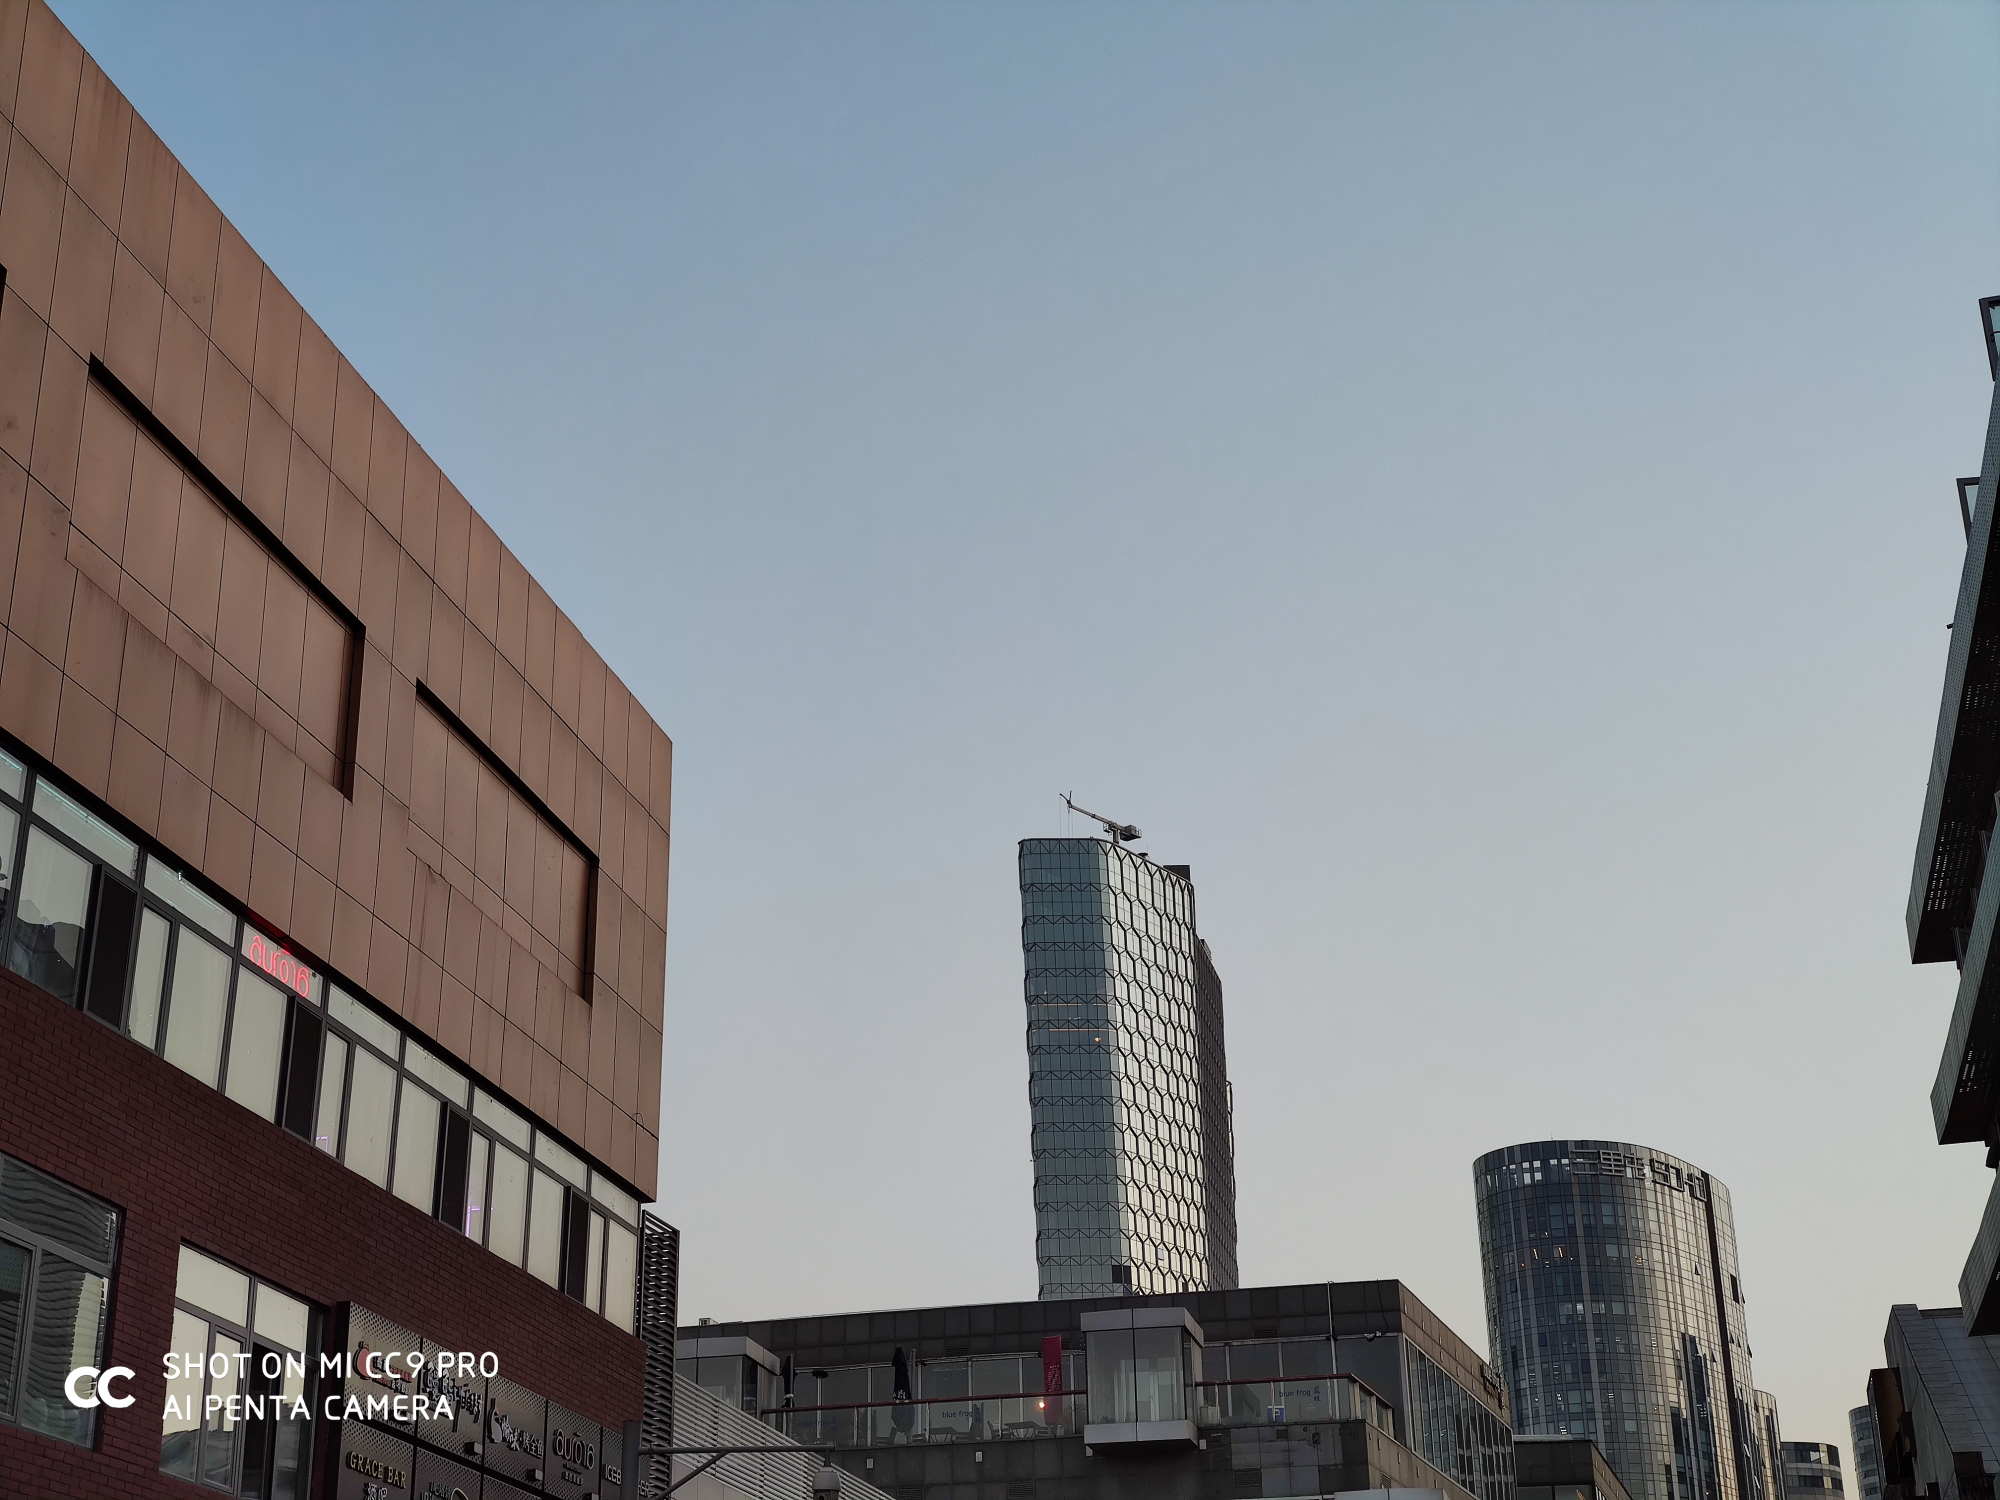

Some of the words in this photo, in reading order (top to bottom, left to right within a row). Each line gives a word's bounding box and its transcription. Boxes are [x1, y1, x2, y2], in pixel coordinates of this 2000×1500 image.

[1571, 1149, 1646, 1180] 三里屯
[1650, 1158, 1707, 1202] SOHO
[1278, 1390, 1294, 1398] blue
[1296, 1389, 1311, 1397] frog
[942, 1411, 957, 1419] blue
[347, 1451, 384, 1480] GRACE
[386, 1466, 407, 1490] BAR
